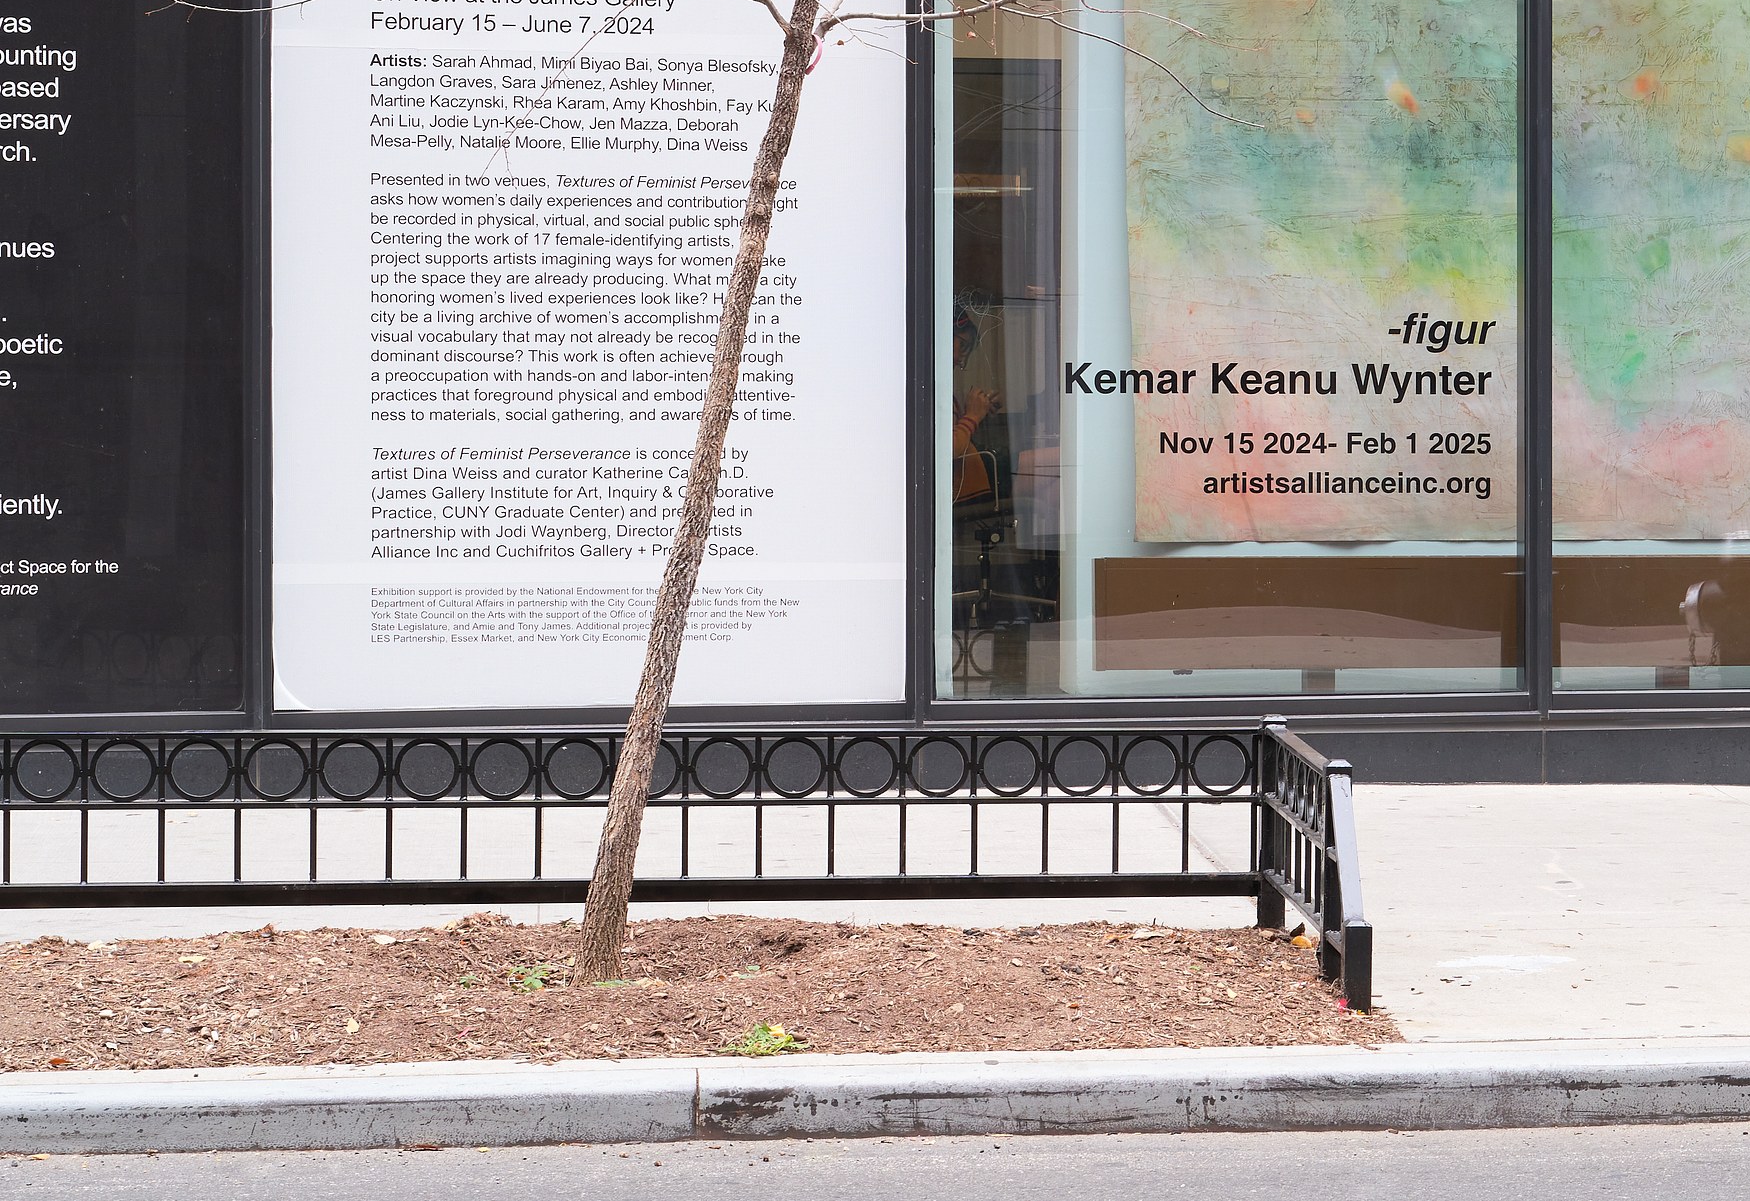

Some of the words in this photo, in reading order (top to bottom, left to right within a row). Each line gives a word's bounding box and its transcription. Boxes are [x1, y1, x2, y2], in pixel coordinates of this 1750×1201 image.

[370, 11, 464, 36] February
[473, 13, 496, 32] 15
[522, 14, 575, 33] June
[603, 15, 654, 35] 2024
[369, 53, 426, 67] Artists:
[432, 54, 475, 68] Sarah
[479, 55, 536, 70] Ahmad,
[541, 56, 575, 70] Mimi
[580, 56, 620, 74] Biyao
[625, 57, 652, 72] Bai,
[657, 58, 703, 75] Sonya
[708, 58, 778, 76] Blesofsky,
[370, 73, 434, 91] Langdon
[439, 74, 496, 89] Graves,
[501, 75, 536, 89] Sara
[540, 77, 605, 93] Jimenez,
[609, 77, 658, 94] Ashley
[663, 78, 714, 93] Minner,
[370, 93, 425, 107] Martine
[430, 94, 507, 112] Kaczynski,
[513, 94, 552, 112] Rhea
[557, 96, 608, 111] Karam,
[612, 97, 646, 113] Amy
[650, 97, 721, 113] Khoshbin,
[726, 98, 753, 115] Fay
[369, 113, 393, 127] Ani
[399, 114, 424, 129] Liu,
[429, 114, 468, 128] Jodie
[473, 113, 584, 132] Lyn-Kee-Chow,
[589, 116, 615, 130] Jen
[620, 117, 671, 132] Mazza,
[677, 117, 738, 132] Deborah
[370, 134, 454, 151] Mesa-Pelly,
[460, 134, 511, 146] Natalie
[515, 135, 565, 149] Moore,
[571, 136, 600, 149] Ellie
[605, 136, 661, 153] Murphy,
[667, 137, 699, 151] Dina
[704, 138, 748, 152] Weiss
[371, 172, 443, 186] Presented
[448, 173, 460, 186] in
[465, 174, 490, 185] two
[494, 178, 549, 189] venues,
[556, 174, 615, 188] Textures
[619, 175, 635, 188] of
[636, 175, 696, 189] Feminist
[700, 176, 797, 191] Persevce
[370, 231, 442, 248] Centering
[447, 232, 470, 245] the
[474, 232, 509, 245] work
[514, 232, 529, 245] of
[534, 232, 550, 245] 17
[555, 232, 682, 250] female-identifying
[687, 234, 734, 248] artists,
[1387, 312, 1497, 353] -figur
[1064, 362, 1196, 395] Kemar
[1211, 362, 1338, 395] Keanu
[1352, 363, 1493, 403] Wynter
[1159, 431, 1214, 454] Nov
[1224, 432, 1254, 454] 15
[1263, 432, 1337, 455] 2024-
[1347, 432, 1397, 454] Feb
[1407, 433, 1418, 454] 1
[1428, 433, 1492, 455] 2025
[371, 486, 426, 502] (James
[432, 486, 485, 502] Gallery
[491, 486, 548, 499] Institute
[553, 485, 573, 499] for
[576, 486, 602, 500] Art,
[608, 485, 657, 502] Inquiry
[662, 485, 673, 498] &
[1203, 471, 1492, 499] artistsallianceinc.org
[18, 559, 67, 577] Space
[71, 560, 91, 574] for
[95, 560, 119, 574] the
[371, 587, 415, 596] Exhibition
[418, 588, 452, 597] support
[454, 587, 462, 595] is
[465, 587, 504, 597] provided
[506, 587, 517, 598] by
[519, 587, 534, 595] the
[536, 587, 573, 595] National
[576, 586, 629, 595] Endowment
[631, 586, 643, 595] for
[646, 587, 659, 596] the
